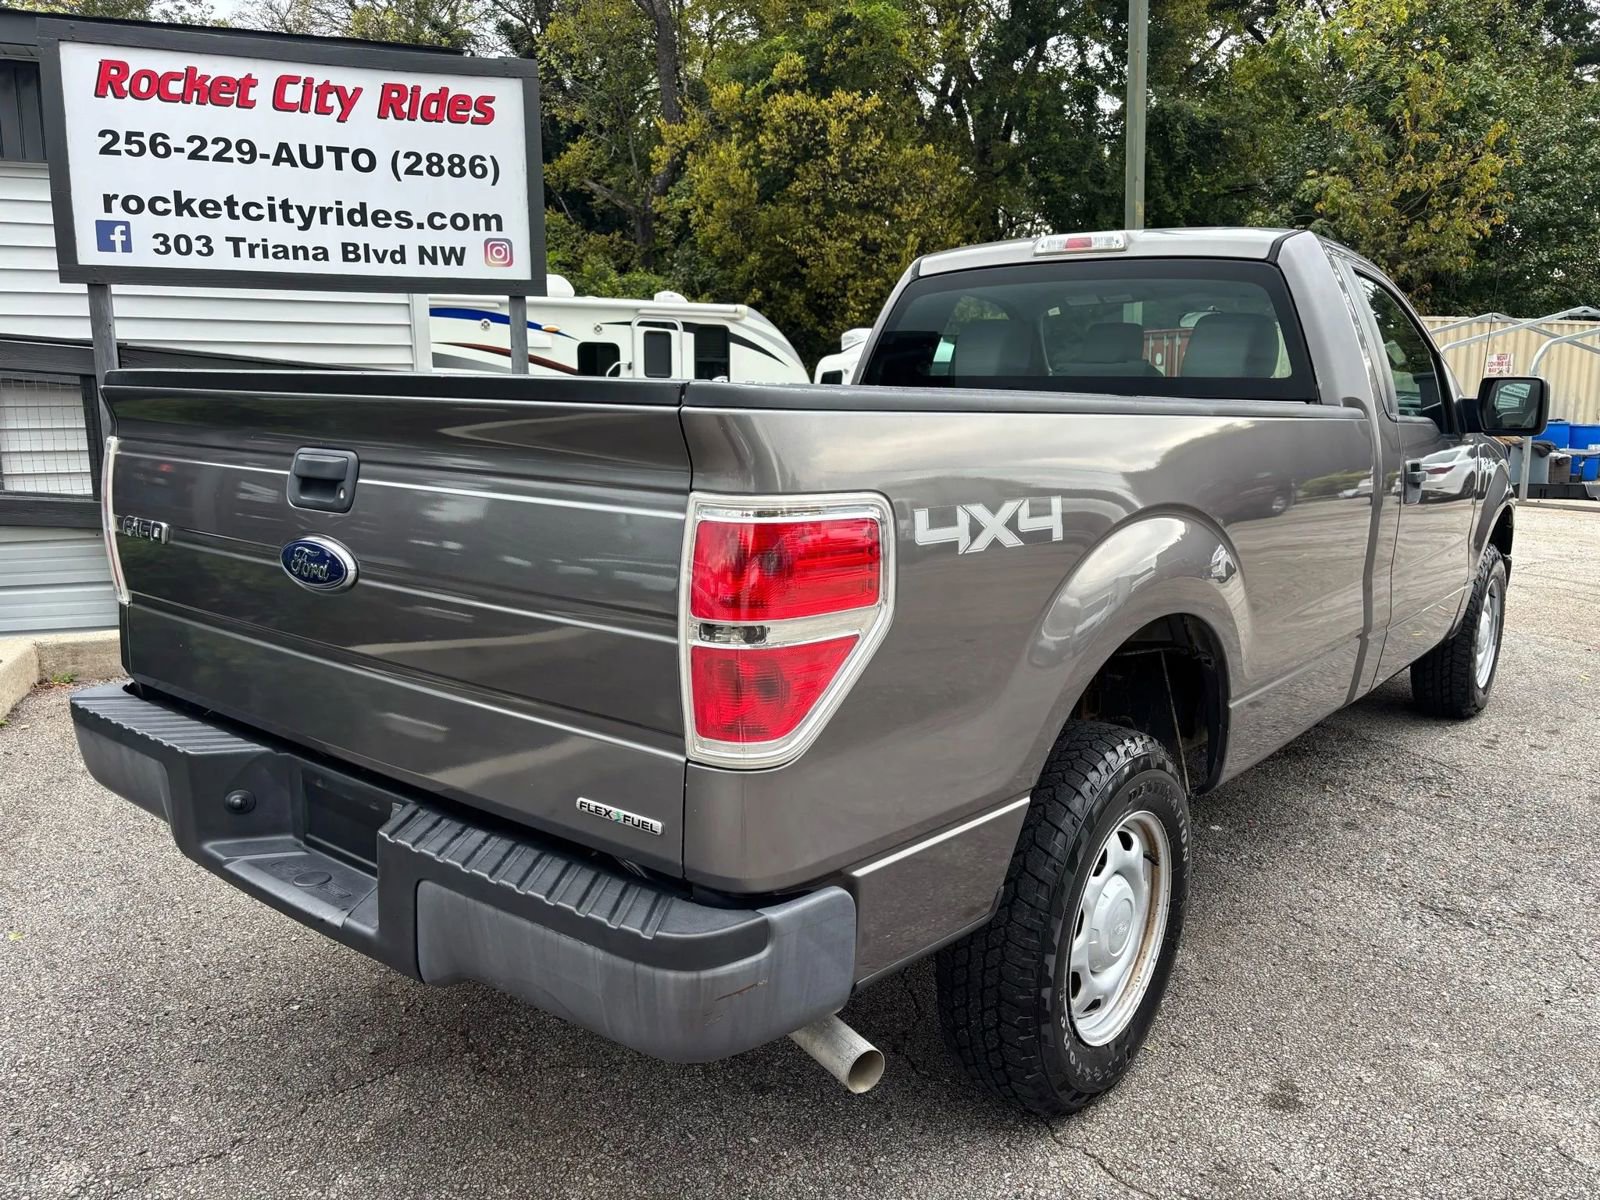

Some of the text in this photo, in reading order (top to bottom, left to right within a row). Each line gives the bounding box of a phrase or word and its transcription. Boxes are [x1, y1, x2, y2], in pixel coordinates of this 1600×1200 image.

[94, 59, 496, 126] Rocket City Rides
[98, 129, 501, 187] 256-229-AUTO (2886)
[102, 190, 504, 232] rocketcityrides.com
[152, 232, 467, 267] 303 Triana Blvd NW
[288, 546, 332, 581] Ford
[579, 800, 658, 834] FLEX FUEL
